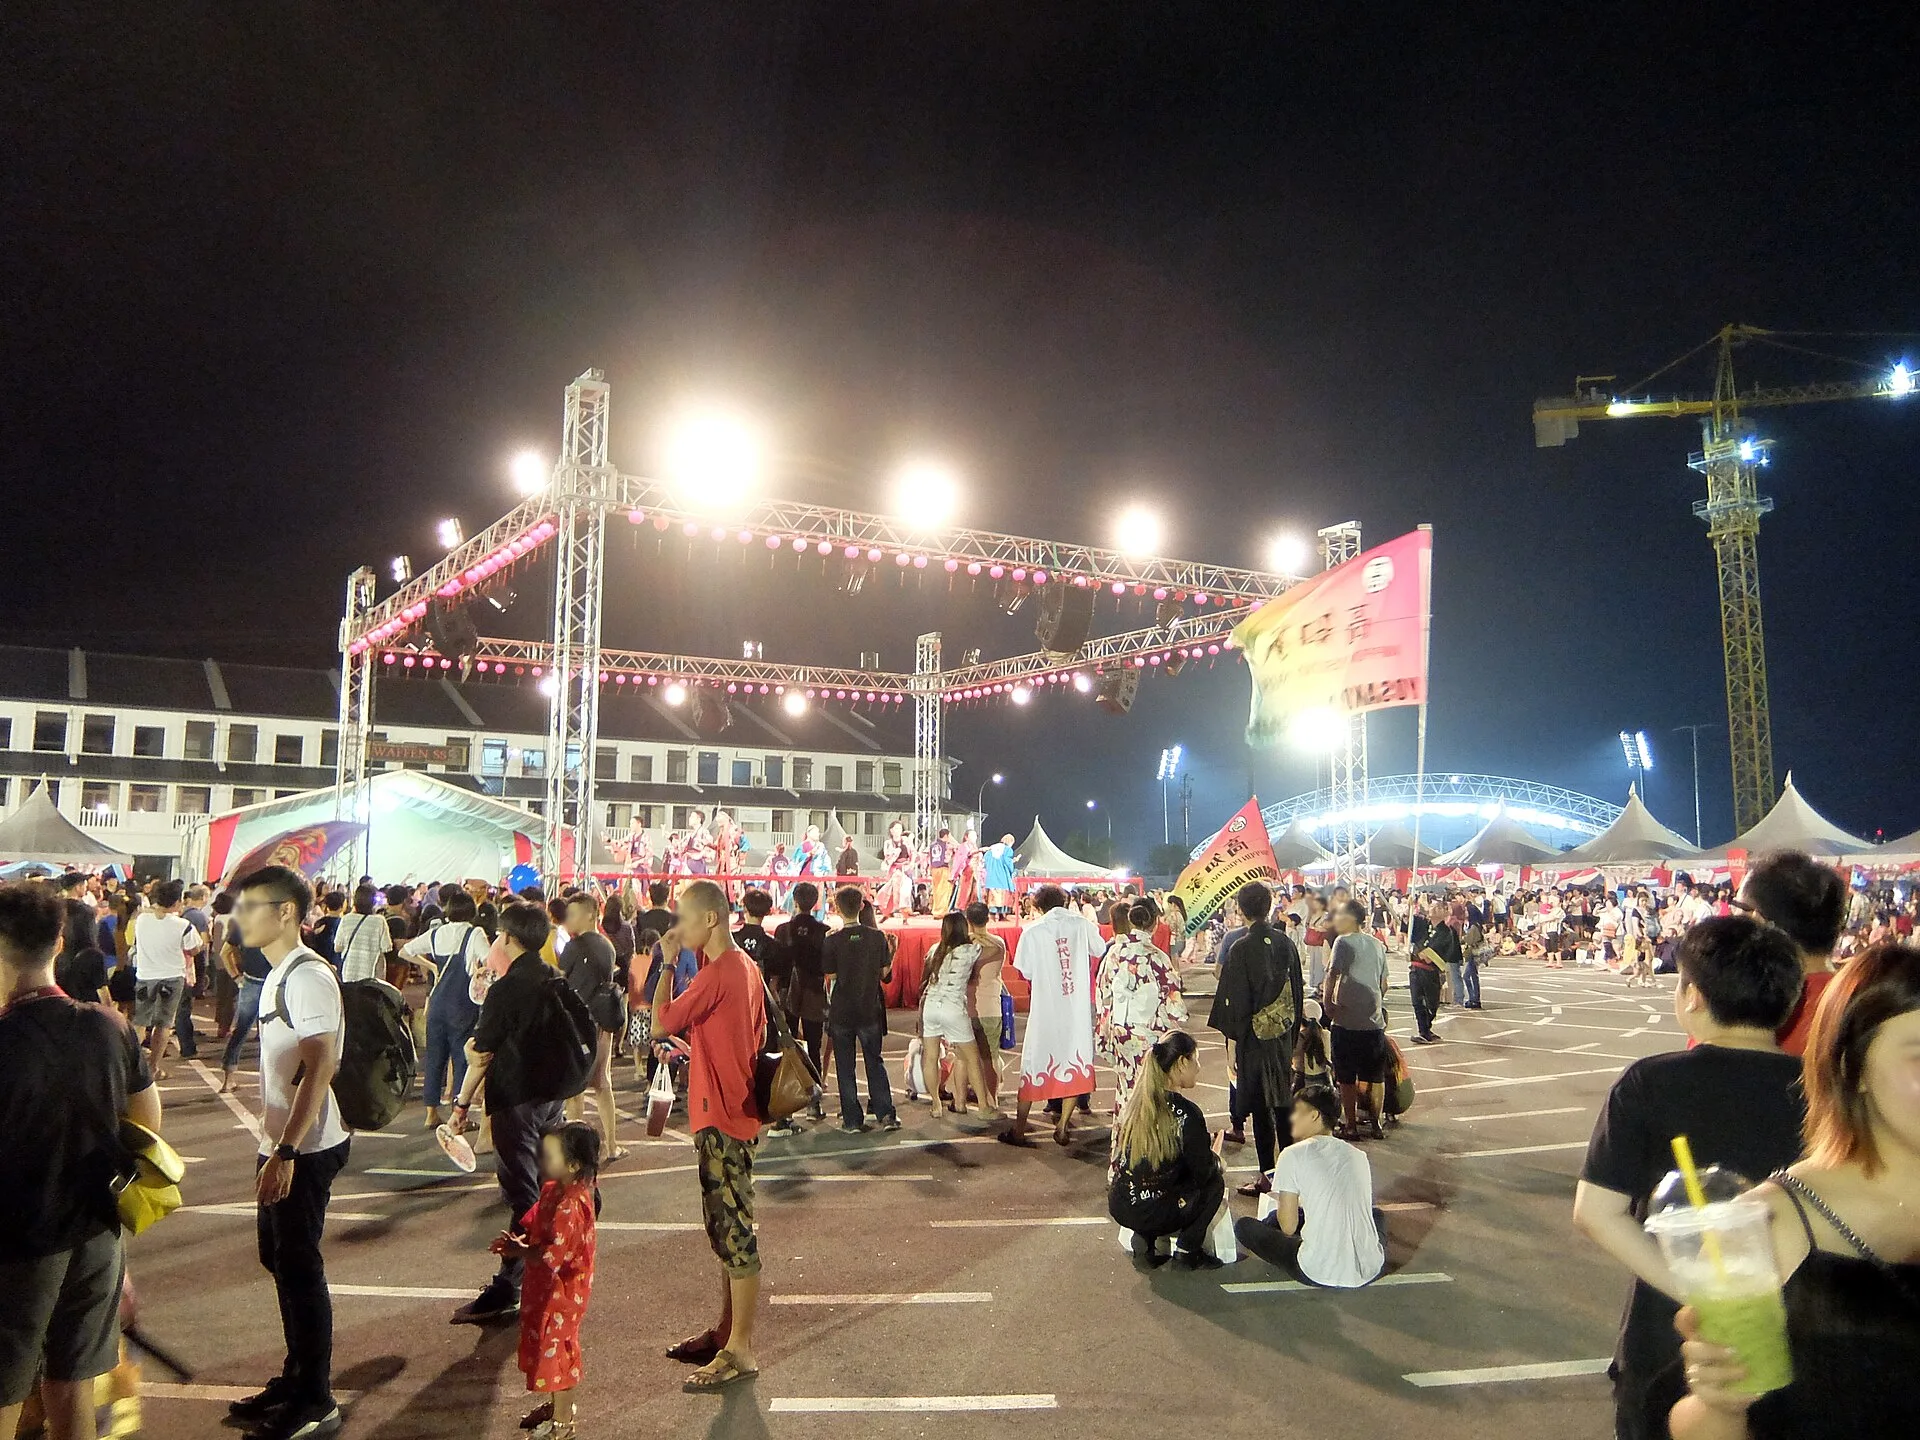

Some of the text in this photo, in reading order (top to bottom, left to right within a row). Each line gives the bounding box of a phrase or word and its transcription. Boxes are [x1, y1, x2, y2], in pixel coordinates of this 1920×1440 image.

[1055, 937, 1075, 996] 四代目火影
